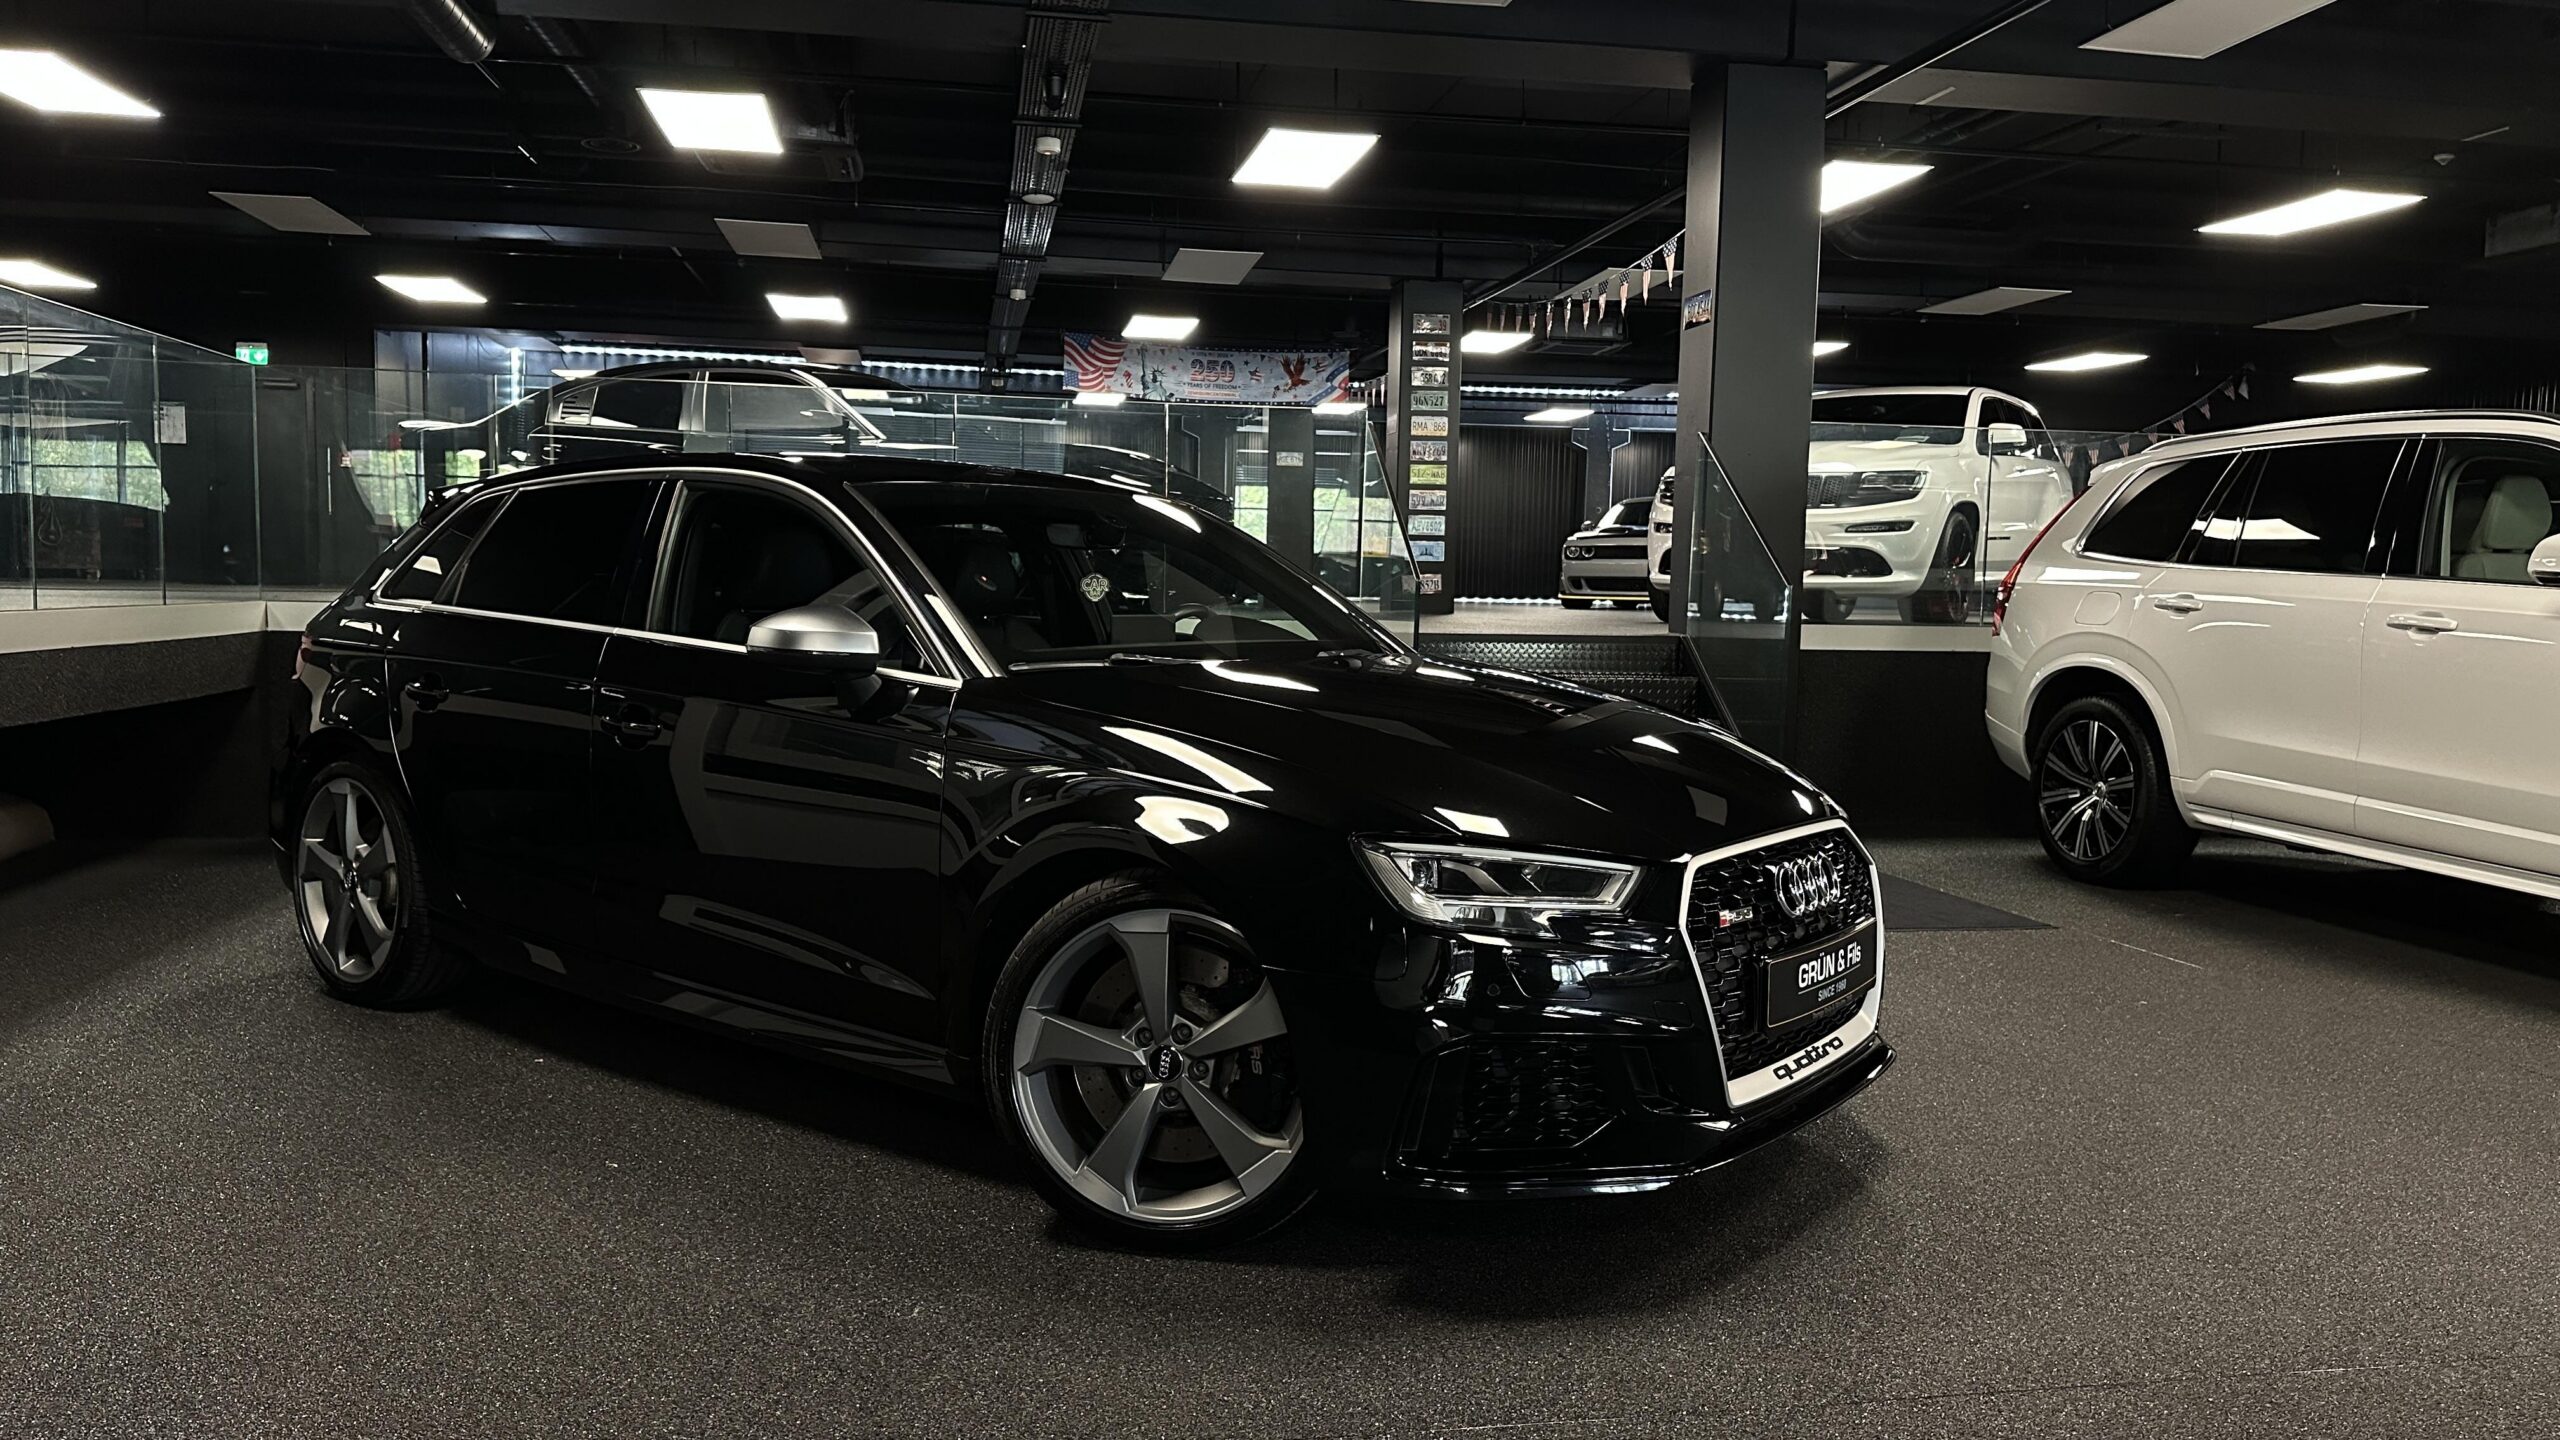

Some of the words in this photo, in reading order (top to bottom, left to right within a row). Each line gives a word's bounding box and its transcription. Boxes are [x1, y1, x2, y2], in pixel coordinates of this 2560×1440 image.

[1190, 359, 1235, 383] 250
[1081, 578, 1108, 591] CAR
[1798, 951, 1835, 988] GRÜN
[1837, 948, 1846, 972] &
[1847, 941, 1862, 968] Fils
[1818, 984, 1835, 1002] SINCE
[1773, 1036, 1844, 1081] quattro
